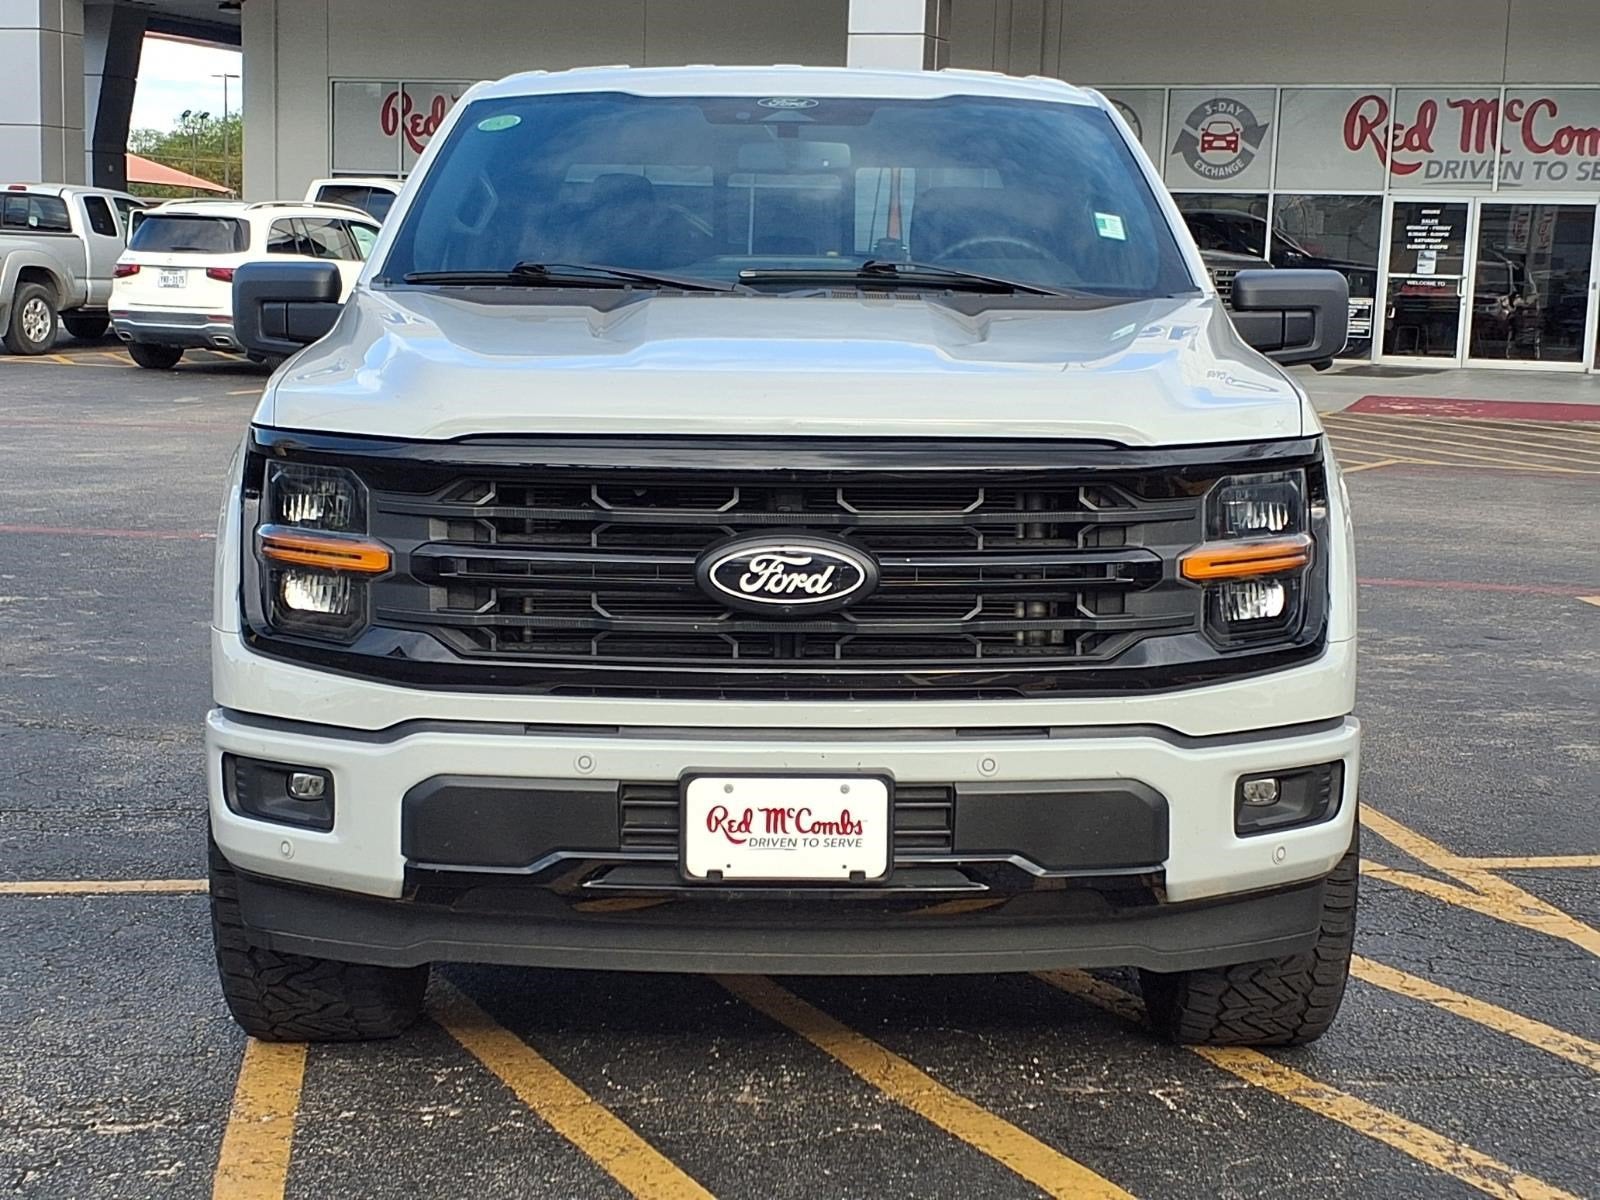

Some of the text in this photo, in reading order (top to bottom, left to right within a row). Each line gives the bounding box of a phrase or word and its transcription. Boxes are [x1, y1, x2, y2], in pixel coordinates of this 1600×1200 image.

[1204, 102, 1244, 116] 3-DAY
[1344, 94, 1438, 175] Red
[1194, 159, 1245, 177] EXCHANGE
[1424, 160, 1524, 180] DRIVEN
[1533, 161, 1568, 181] TO
[739, 554, 835, 594] Ford
[706, 805, 863, 845] Red McCombs
[748, 837, 863, 848] DRIVEN TO SERVE
